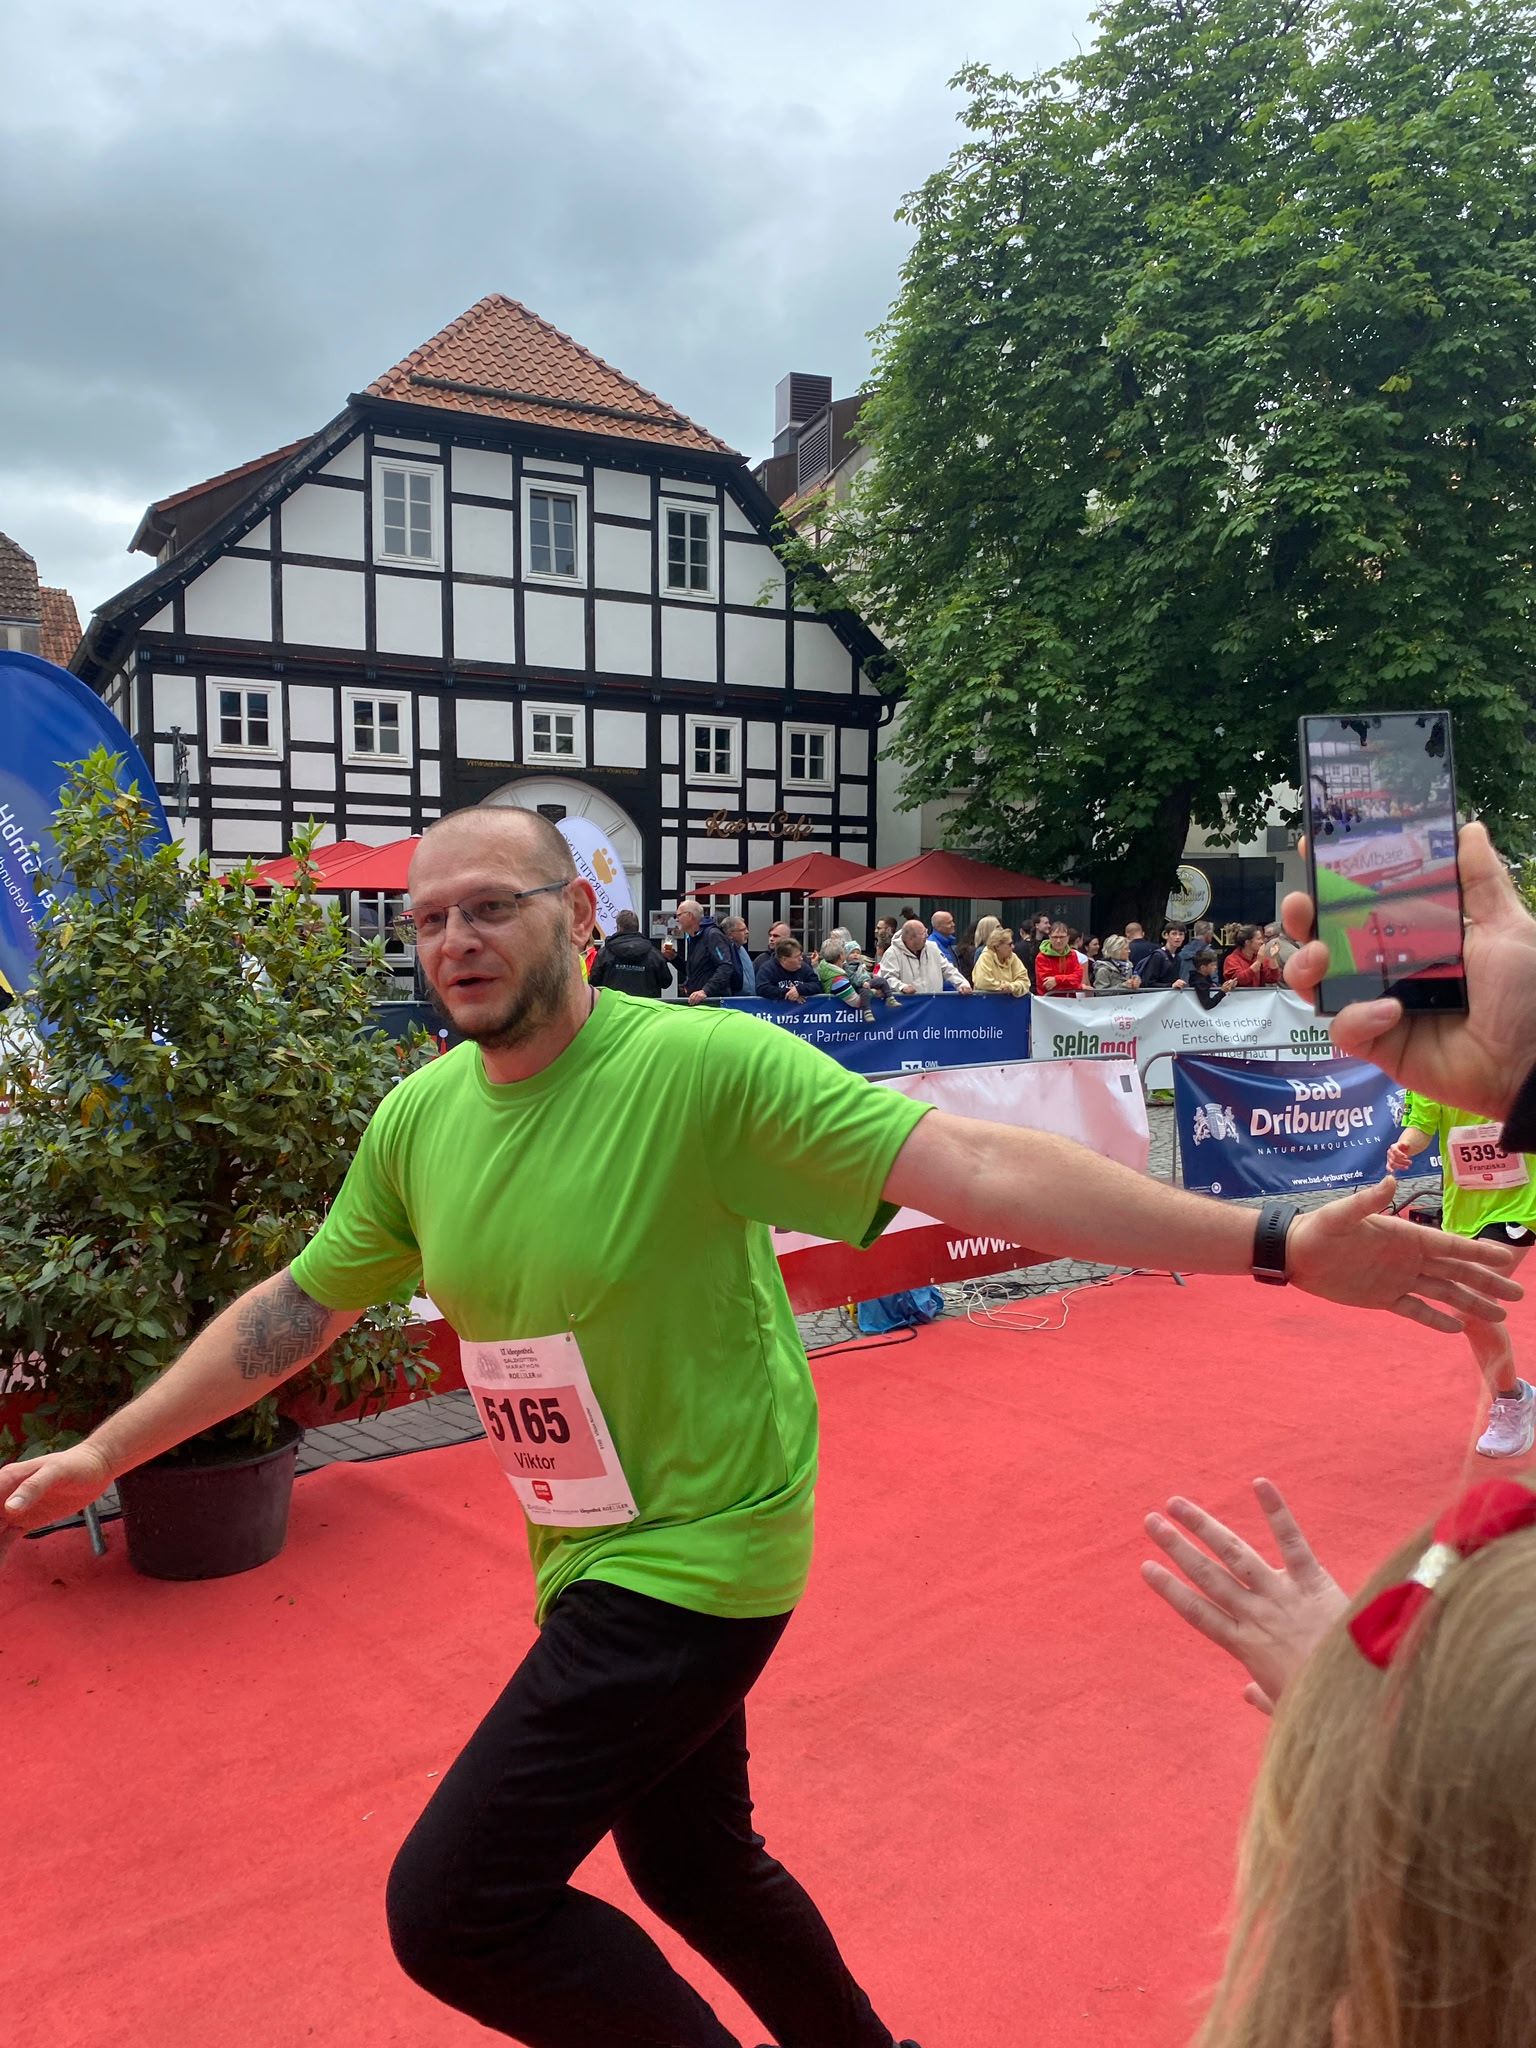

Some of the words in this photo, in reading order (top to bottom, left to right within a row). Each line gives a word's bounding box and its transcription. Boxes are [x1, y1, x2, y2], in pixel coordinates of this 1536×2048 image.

[777, 1015, 799, 1024] uns
[803, 1013, 831, 1024] zum
[835, 1009, 863, 1023] Ziel!
[1161, 1018, 1213, 1029] Weltweit
[1214, 1018, 1231, 1028] die
[1233, 1017, 1272, 1029] richtige
[816, 1029, 860, 1042] Partner
[864, 1027, 894, 1041] rund
[897, 1030, 919, 1040] um
[922, 1026, 941, 1039] die
[944, 1026, 1003, 1039] Immobilie
[1182, 1033, 1258, 1044] Entscheidung
[1287, 1075, 1342, 1102] Bad
[1250, 1105, 1374, 1137] Driburger
[1257, 1136, 1381, 1155] NATURPARKQUELLEN
[1291, 1170, 1363, 1186] www.bad-driburger.de
[482, 1397, 571, 1444] 5165
[513, 1452, 556, 1470] Viktor
